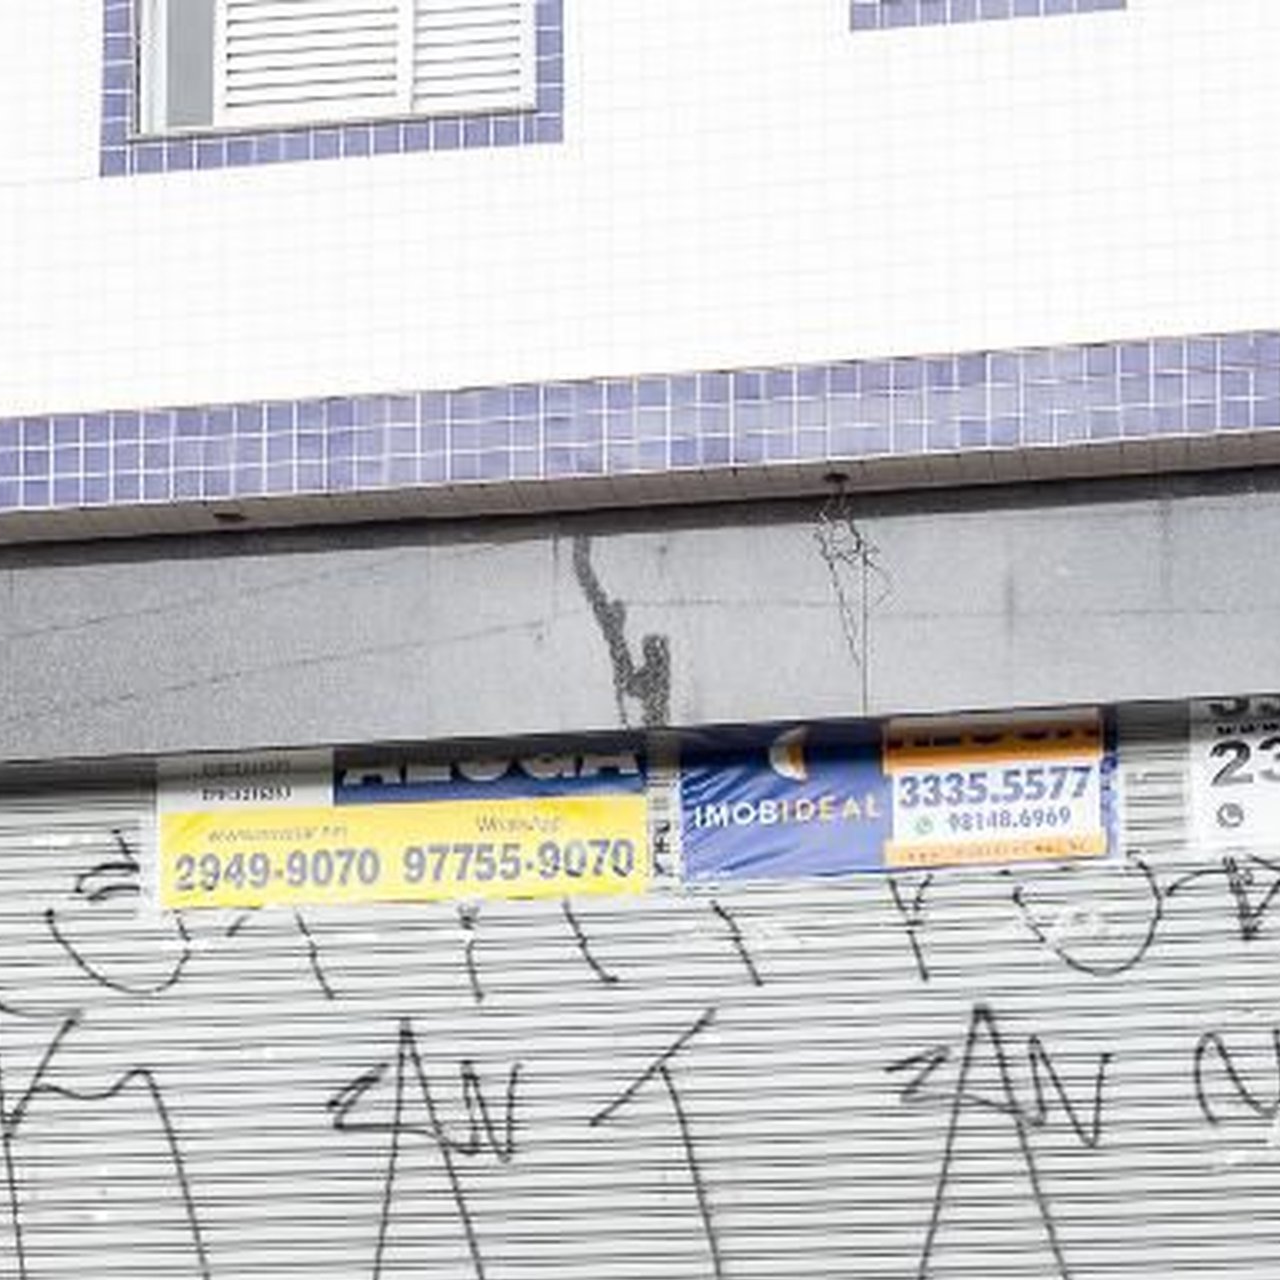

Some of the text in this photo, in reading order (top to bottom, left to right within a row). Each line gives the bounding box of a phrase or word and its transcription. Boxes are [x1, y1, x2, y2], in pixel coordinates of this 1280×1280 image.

[899, 765, 1093, 808] 3335.5577
[694, 794, 882, 828] IMOBIDEAL
[174, 838, 635, 892] 2949-9070 97755-9070
